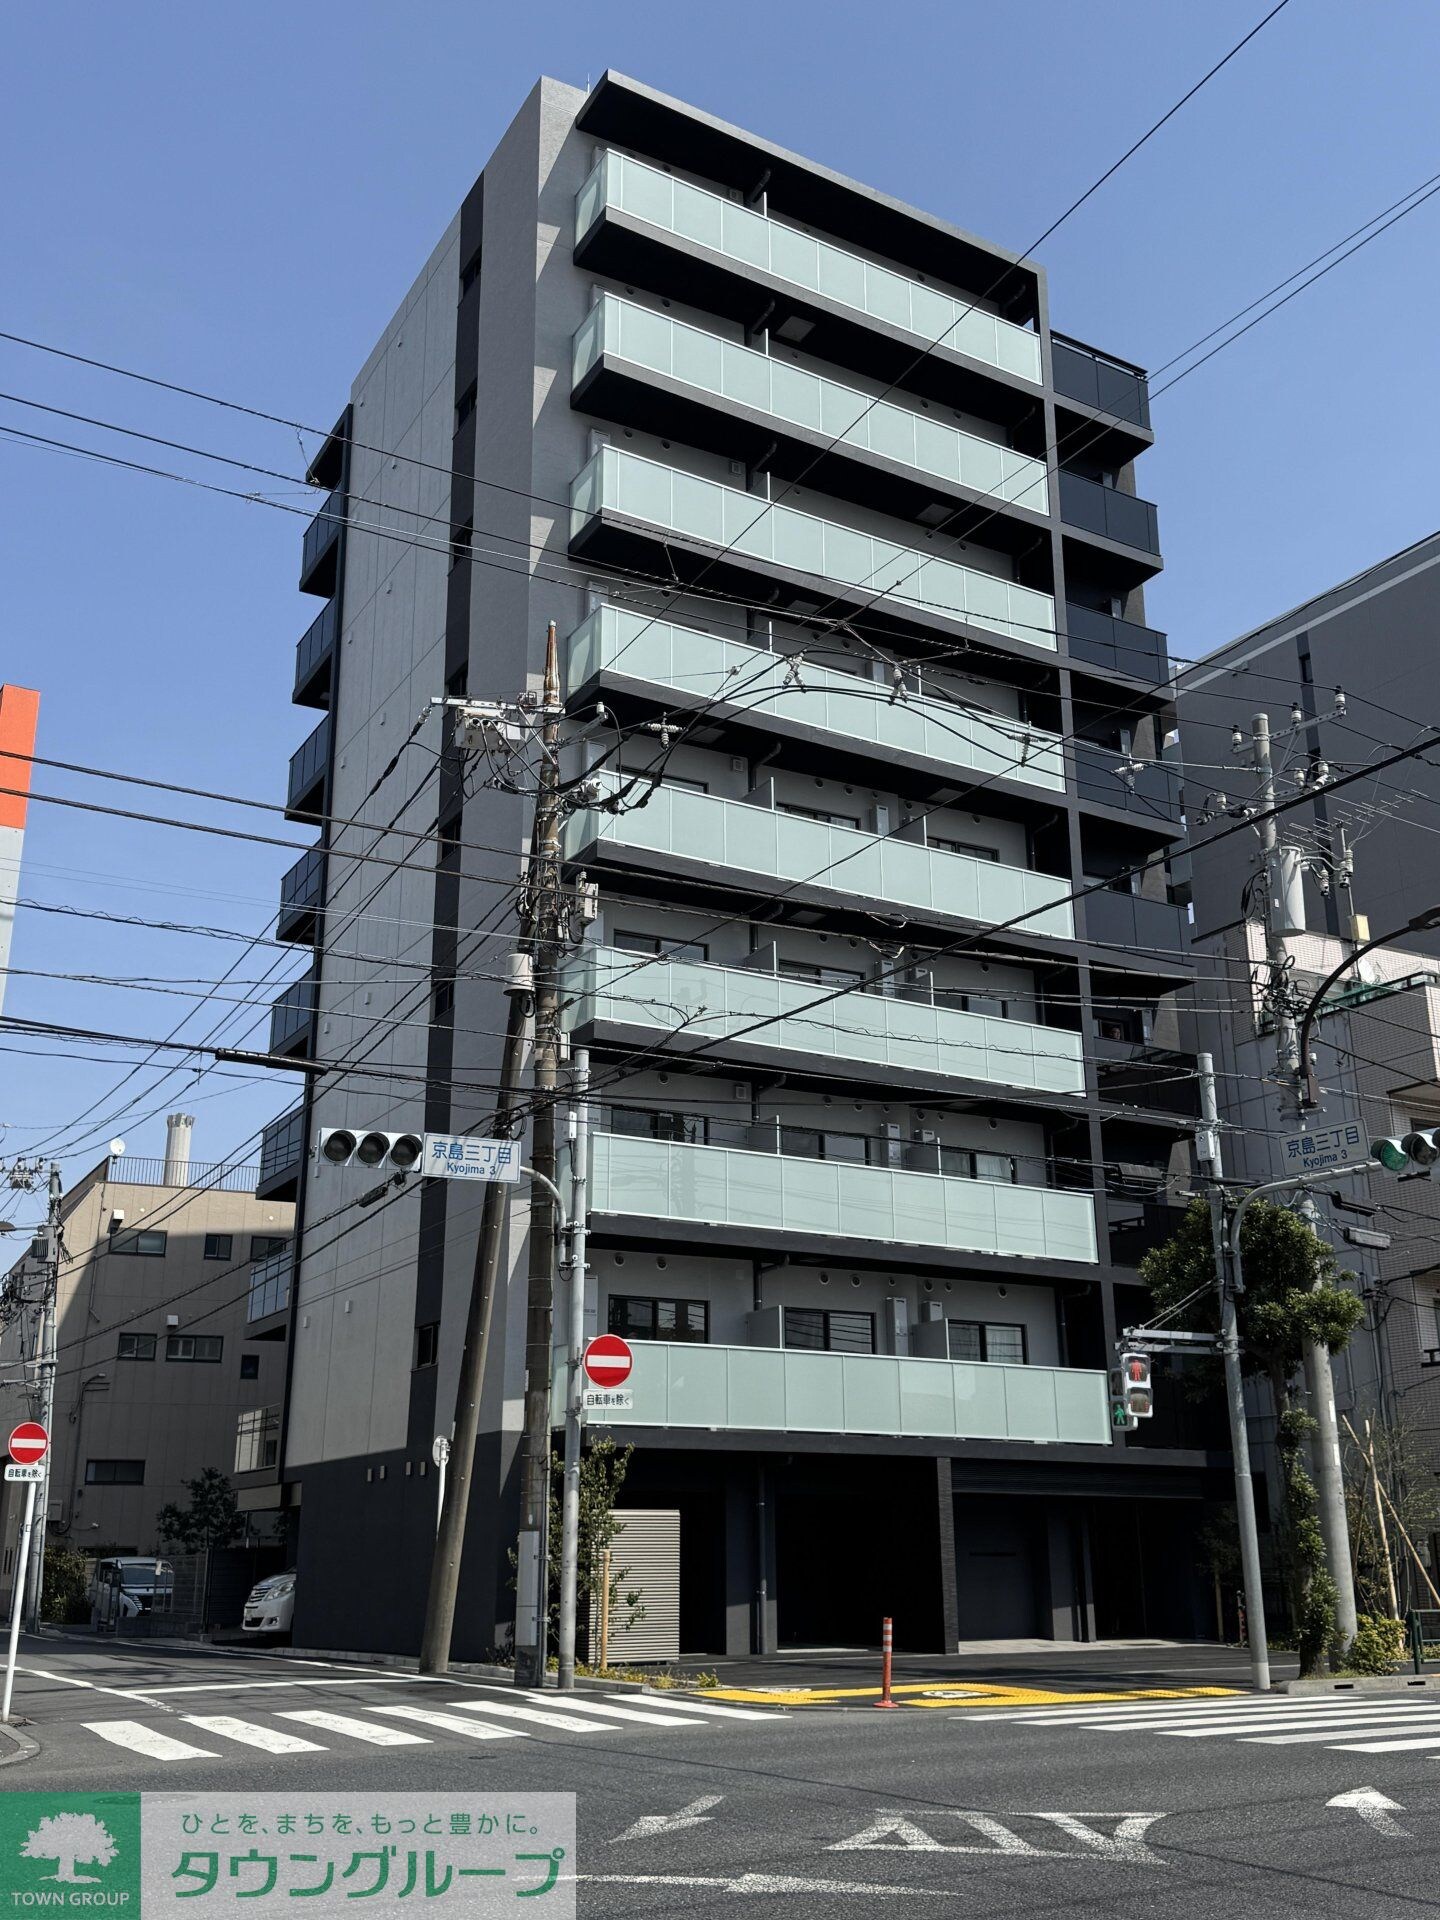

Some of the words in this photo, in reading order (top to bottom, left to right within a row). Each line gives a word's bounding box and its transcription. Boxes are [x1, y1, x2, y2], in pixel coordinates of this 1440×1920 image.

[1286, 1126, 1360, 1158] 京島三丁目
[431, 1141, 511, 1164] 京島三丁目
[1303, 1153, 1338, 1168] Kyojima
[1341, 1150, 1348, 1159] 3
[447, 1162, 485, 1175] Kyojima
[489, 1165, 496, 1175] 3
[586, 1394, 630, 1406] 自転車を除く
